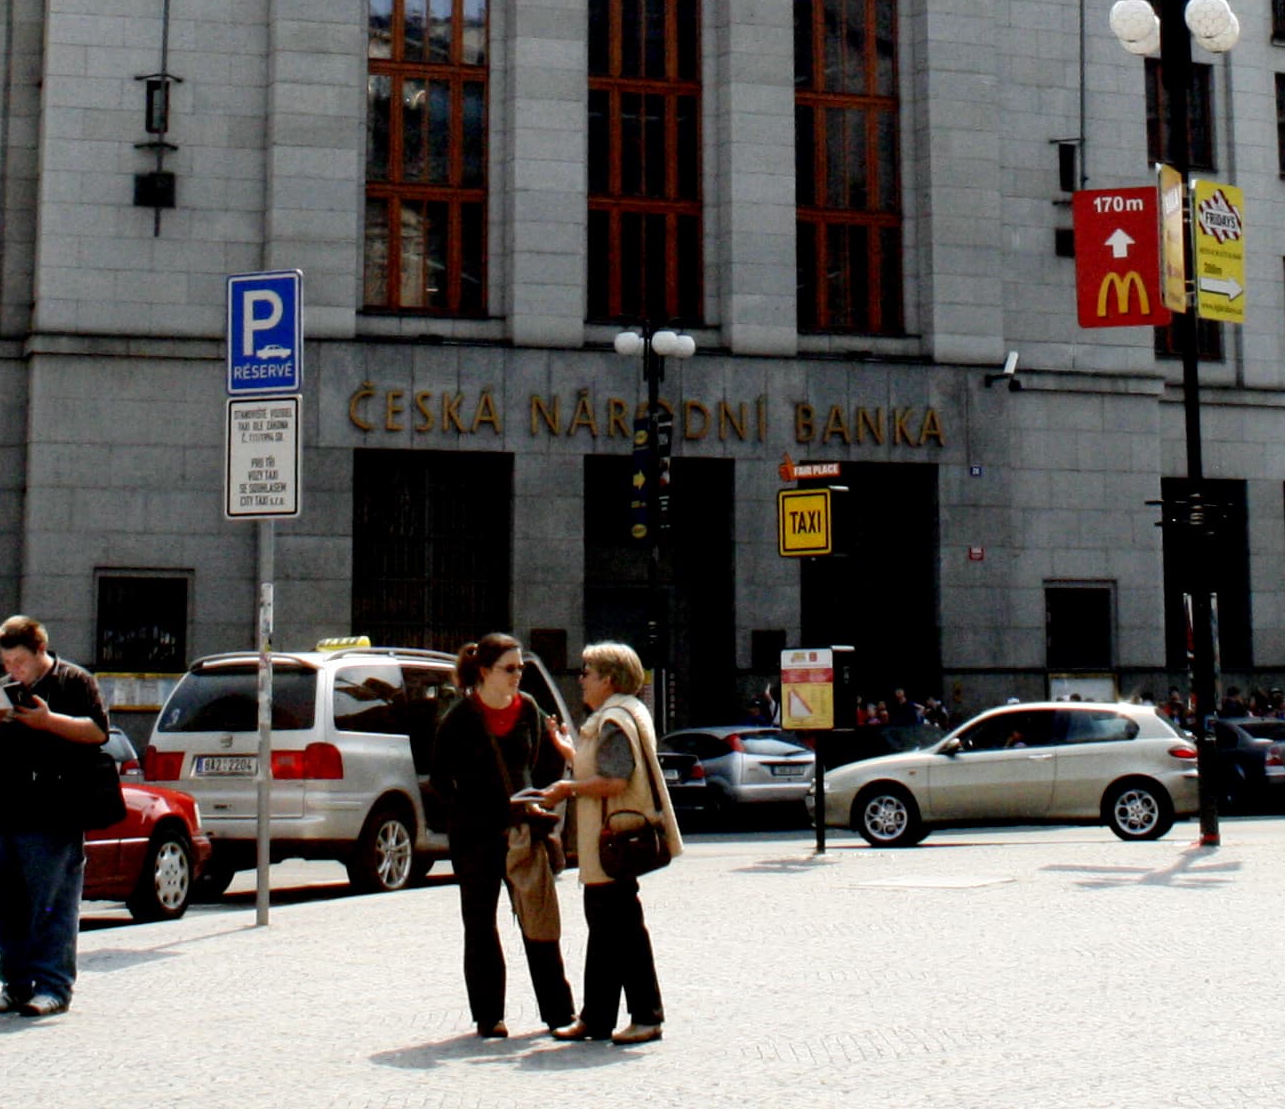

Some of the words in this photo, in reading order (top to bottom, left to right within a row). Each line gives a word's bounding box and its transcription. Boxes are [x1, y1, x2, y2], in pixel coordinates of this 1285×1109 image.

[242, 289, 284, 356] P
[234, 360, 293, 380] RÉSERVÉ
[348, 380, 503, 435] ČESKÁ
[795, 403, 945, 446] BANKA
[265, 470, 279, 480] TAXI
[240, 496, 253, 506] CITY
[255, 495, 269, 506] TAXI
[789, 510, 822, 534] TAXI
